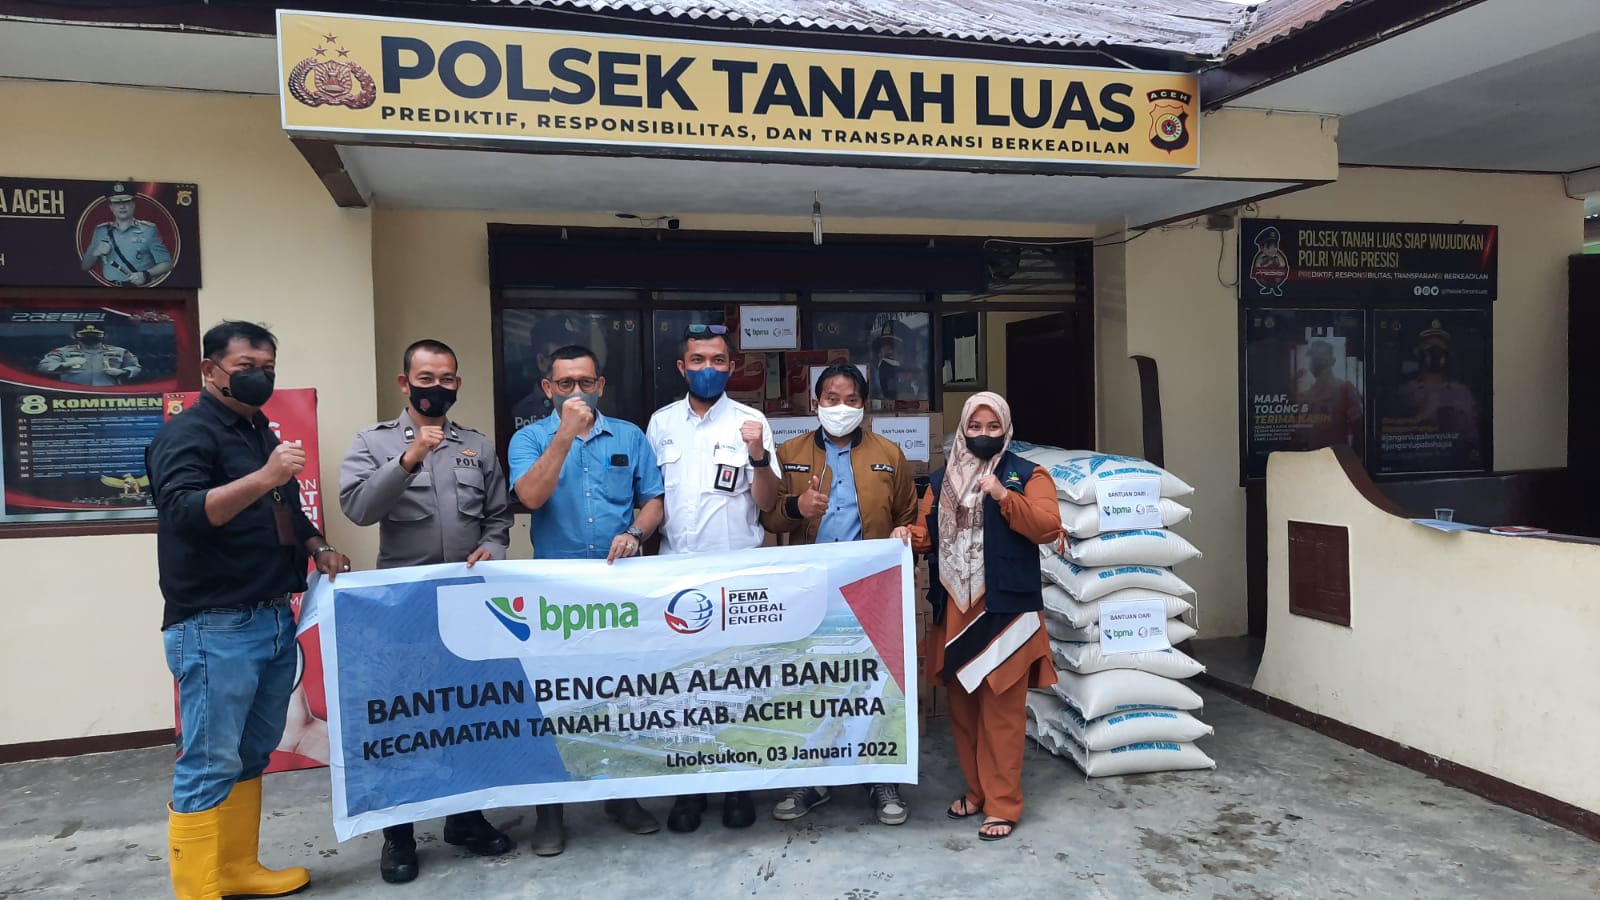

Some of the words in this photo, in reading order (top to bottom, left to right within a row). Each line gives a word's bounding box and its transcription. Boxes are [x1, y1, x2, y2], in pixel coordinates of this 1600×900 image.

[380, 35, 699, 112] POLSEK
[712, 58, 955, 123] TANAH
[975, 75, 1136, 133] LUAS
[1150, 91, 1188, 101] ACEH
[381, 106, 527, 130] PREDIKTIF,
[537, 113, 757, 142] RESPONSIBILITAS,
[766, 126, 813, 142] DAN
[822, 129, 983, 149] TRANSPARANSI
[992, 136, 1130, 155] BERKEADILAN
[12, 188, 65, 214] ACEH
[1298, 230, 1339, 247] POLSEK
[1341, 231, 1374, 248] TANAH
[1376, 232, 1402, 249] LUAS
[1404, 232, 1427, 249] SIAP
[1429, 233, 1484, 250] WUJUDKAN
[1298, 250, 1329, 267] POLRI
[1331, 250, 1359, 268] YANG
[1361, 251, 1399, 268] PRESISI
[20, 395, 48, 415] 8
[52, 397, 163, 409] KOMITMEN
[1254, 393, 1289, 404] MAAF,
[1254, 404, 1299, 414] TOLONG
[1112, 505, 1132, 516] bpma
[539, 595, 639, 640] bpma
[728, 591, 768, 602] PEMA
[728, 603, 788, 616] GLOBAL
[728, 613, 783, 625] ENERGI
[1113, 629, 1134, 639] bpma
[367, 679, 525, 725] BANTUAN
[534, 671, 680, 702] BENCANA
[687, 664, 772, 693] ALAM
[781, 658, 879, 687] BANJIR
[363, 718, 520, 761] KECAMATAN
[526, 713, 610, 737] TANAH
[618, 709, 677, 732] LUAS
[683, 706, 736, 728] KAB.
[742, 700, 802, 722] ACEH
[810, 697, 886, 719] UTARA
[666, 748, 763, 768] Lhoksukon,
[766, 746, 788, 761] 03
[791, 742, 853, 761] Januari
[857, 741, 898, 757] 2022
